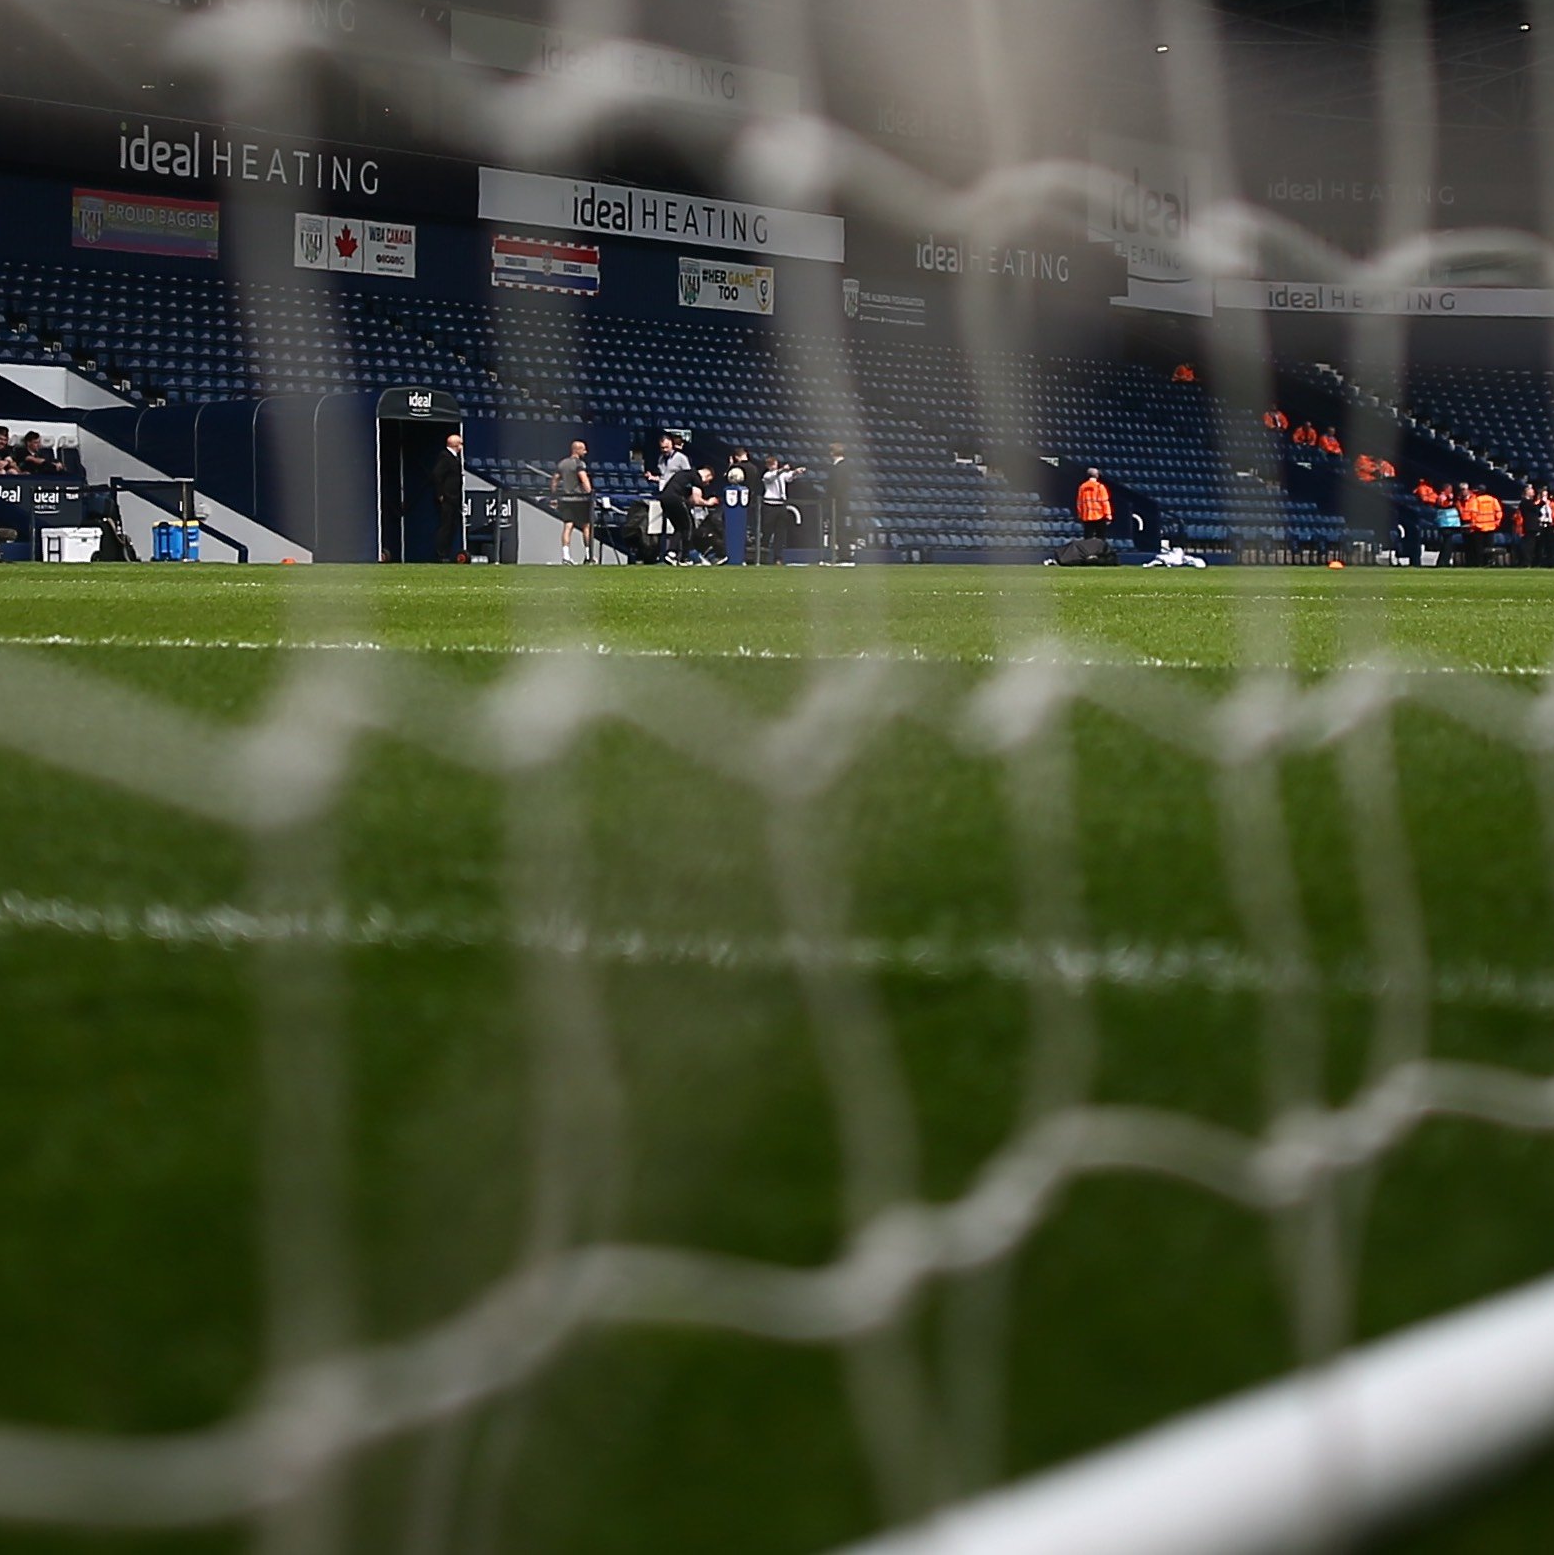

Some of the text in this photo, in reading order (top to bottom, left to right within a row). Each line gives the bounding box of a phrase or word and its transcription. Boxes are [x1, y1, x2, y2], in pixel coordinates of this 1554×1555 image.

[119, 121, 379, 195] ideal HEATING
[108, 203, 214, 229] PROUD BAGGIES
[573, 185, 768, 244] ideal HEATING
[916, 233, 1070, 282] ideal HEATING
[718, 284, 739, 301] TOO
[1268, 285, 1323, 309] ideal
[408, 391, 433, 408] ideal
